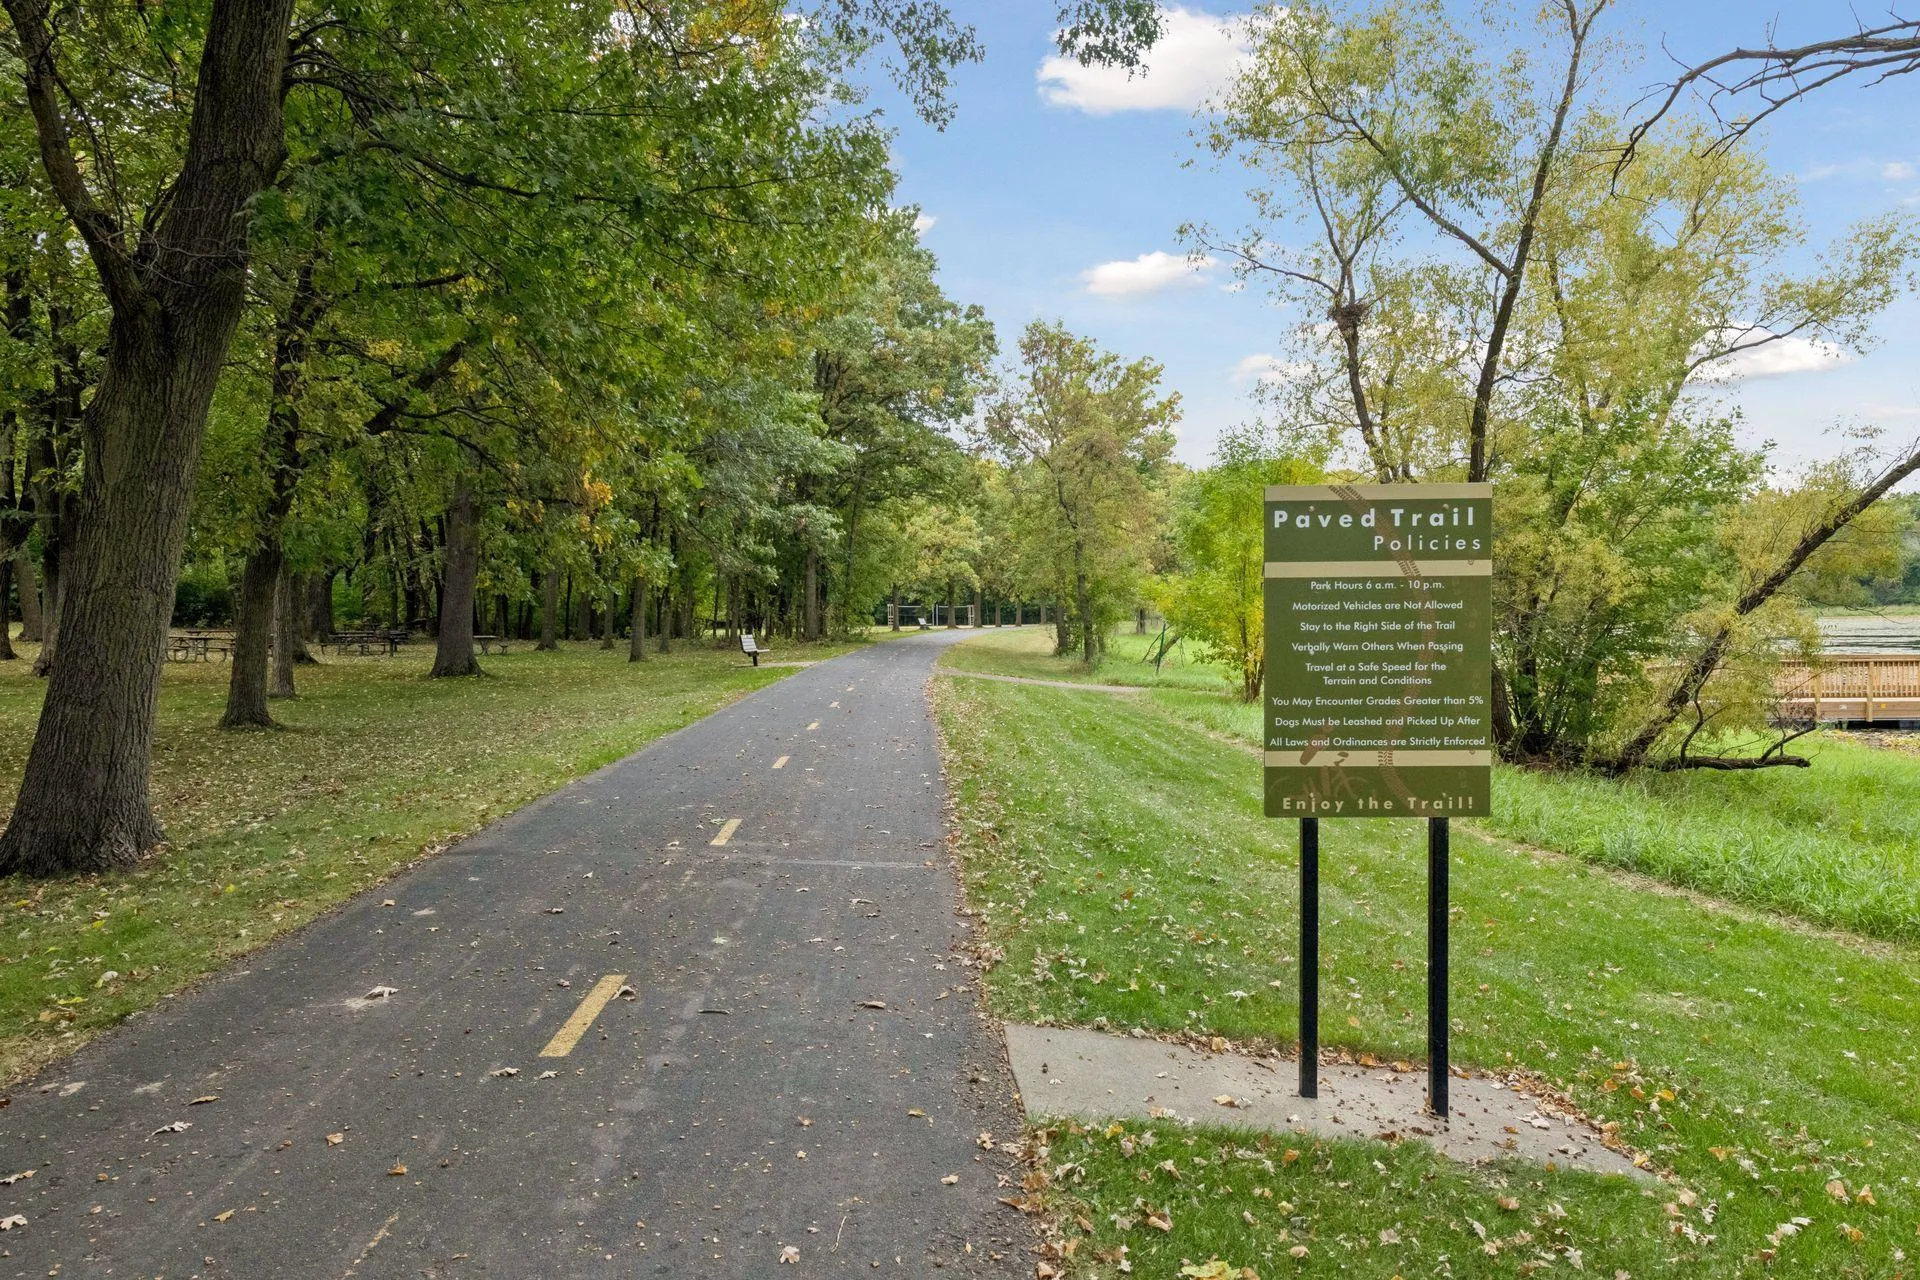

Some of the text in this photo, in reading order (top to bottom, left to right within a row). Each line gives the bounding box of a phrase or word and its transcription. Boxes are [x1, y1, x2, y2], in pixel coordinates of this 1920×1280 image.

[1273, 506, 1474, 529] Paved Trail
[1373, 534, 1481, 551] Policies
[1310, 581, 1332, 590] Park
[1334, 580, 1364, 590] Hours
[1365, 580, 1373, 590] 6
[1375, 582, 1397, 590] a.m.
[1407, 580, 1421, 590] 10
[1423, 581, 1446, 591] p.m.
[1292, 601, 1341, 611] Motorized
[1342, 601, 1382, 610] Vehicles
[1403, 600, 1422, 610] Not
[1423, 600, 1464, 610] Allowed
[1300, 620, 1456, 632] Stay to the Right Side of the Trail
[1332, 642, 1359, 651] Warn
[1361, 641, 1395, 651] Others
[1396, 641, 1426, 650] When
[1427, 641, 1464, 652] Passing
[1304, 662, 1334, 672] Travel
[1336, 663, 1347, 672] at
[1357, 662, 1380, 671] Safe
[1381, 662, 1412, 673] Speed
[1414, 661, 1429, 671] for
[1430, 662, 1447, 671] the
[1322, 675, 1433, 685] Terrain and Conditions
[1271, 695, 1485, 708] You May Encounter Grades Greater than 5%
[1275, 716, 1481, 728] Dogs Must be Leashed and Picked Up After
[1269, 736, 1486, 748] All Laws and Ordinances are Strictly Enforced
[1282, 795, 1474, 812] Enjoy the Trail!
